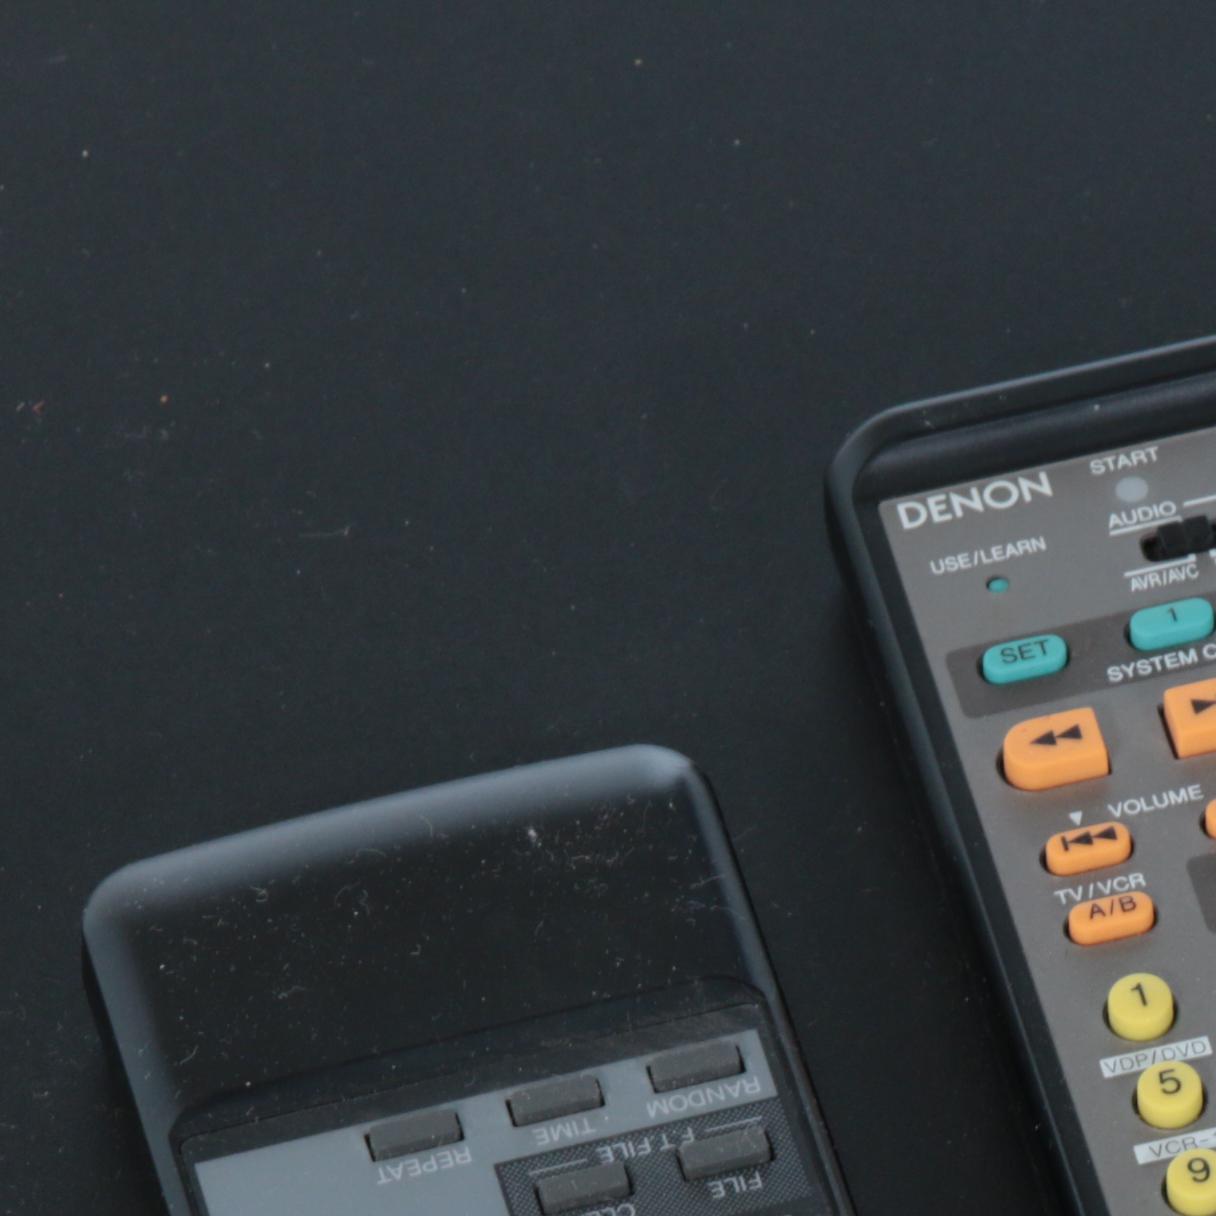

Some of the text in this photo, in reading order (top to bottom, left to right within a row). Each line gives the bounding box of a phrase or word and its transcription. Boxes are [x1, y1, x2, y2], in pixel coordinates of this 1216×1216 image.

[1089, 447, 1160, 476] START
[897, 472, 1054, 530] DENON
[1108, 500, 1178, 529] AUDIO
[930, 536, 1048, 576] USE/LEARN
[1130, 564, 1200, 593] AVR/AVC
[1167, 608, 1179, 623] 1
[1000, 640, 1051, 665] SET
[1106, 648, 1198, 683] SYSTEM
[1108, 784, 1205, 818] VOLUME
[1054, 872, 1146, 906] TV/VCR
[1089, 895, 1137, 920] A/B
[1131, 983, 1148, 1007] 1
[1103, 1039, 1208, 1075] VDP/DVD
[1158, 1069, 1182, 1095] 5
[647, 1076, 761, 1119] RANDOM
[536, 1119, 597, 1147] TIME
[375, 1146, 473, 1186] REPEAT
[1187, 1157, 1211, 1183] 9
[711, 1171, 763, 1199] FILE
